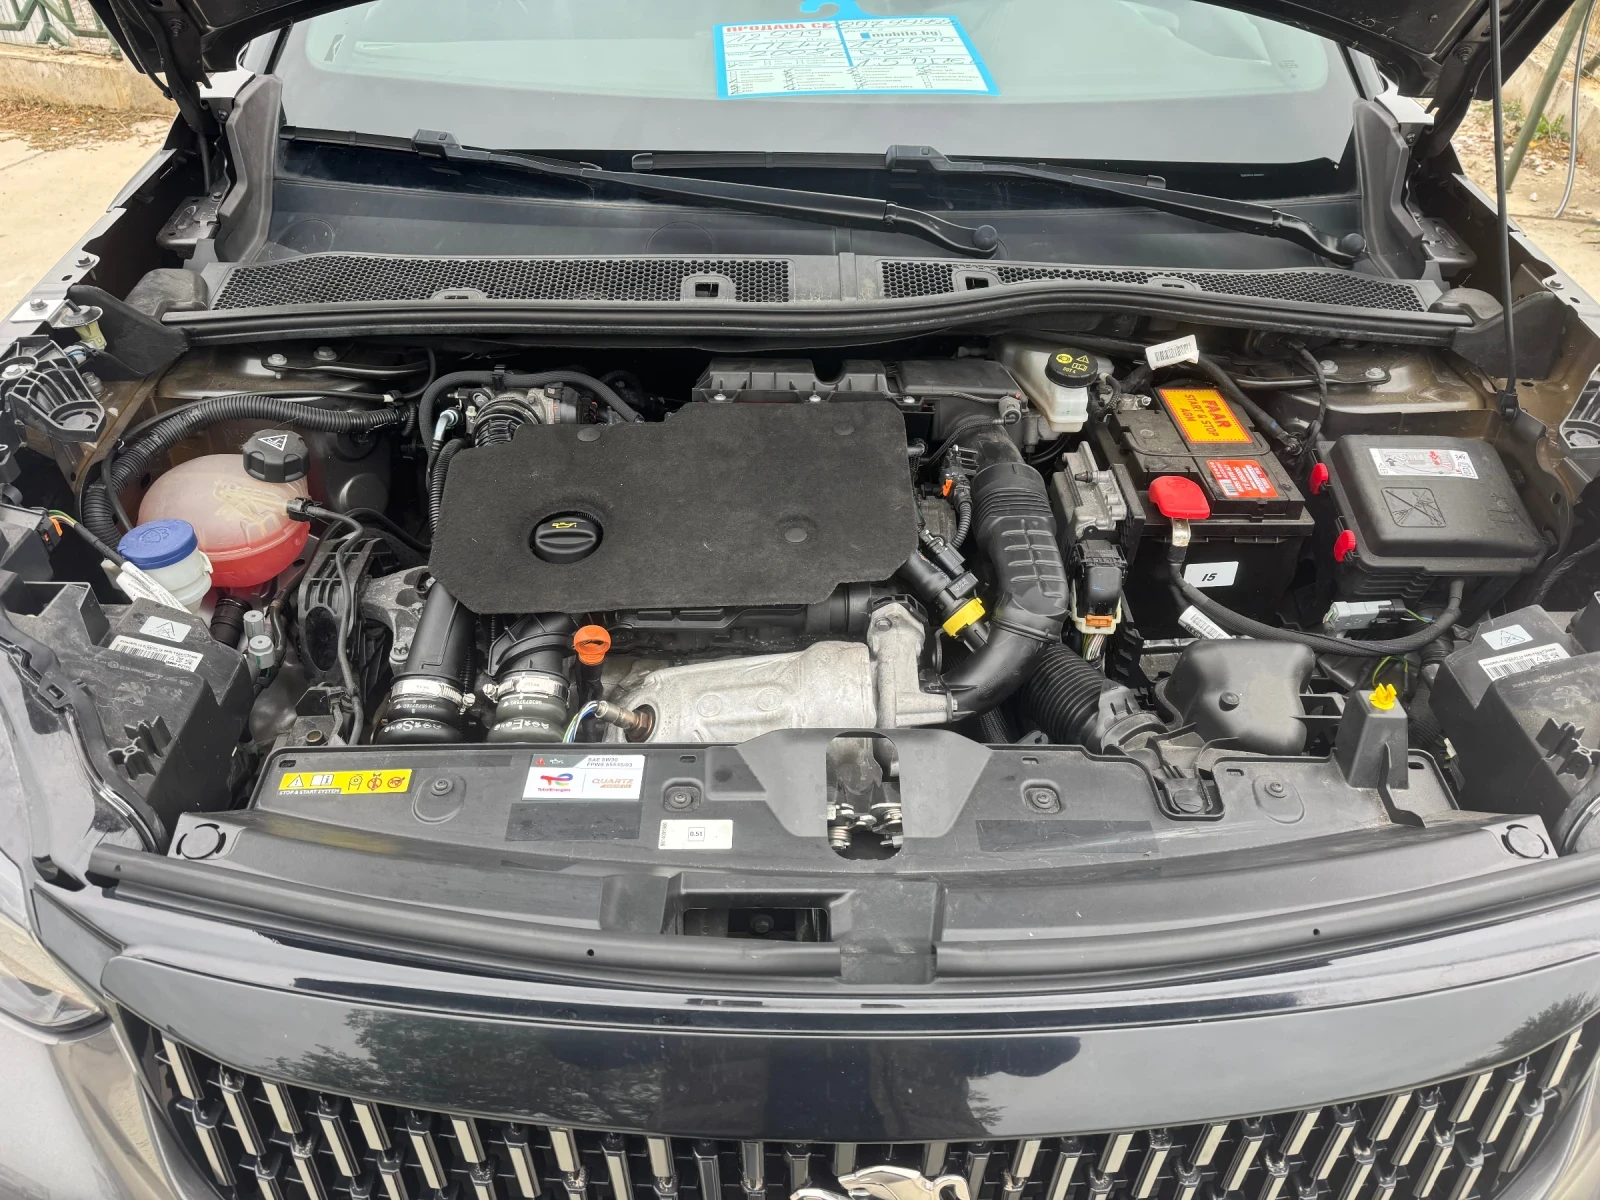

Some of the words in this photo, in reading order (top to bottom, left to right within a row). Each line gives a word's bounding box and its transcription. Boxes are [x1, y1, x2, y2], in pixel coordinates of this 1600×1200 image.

[726, 23, 806, 32] ПРОДАВА
[871, 30, 939, 38] mobile.bg
[1180, 407, 1197, 422] AGM
[1184, 394, 1204, 412] START
[1201, 420, 1219, 437] STOP
[1202, 400, 1232, 428] FAAR
[1201, 573, 1217, 582] 15
